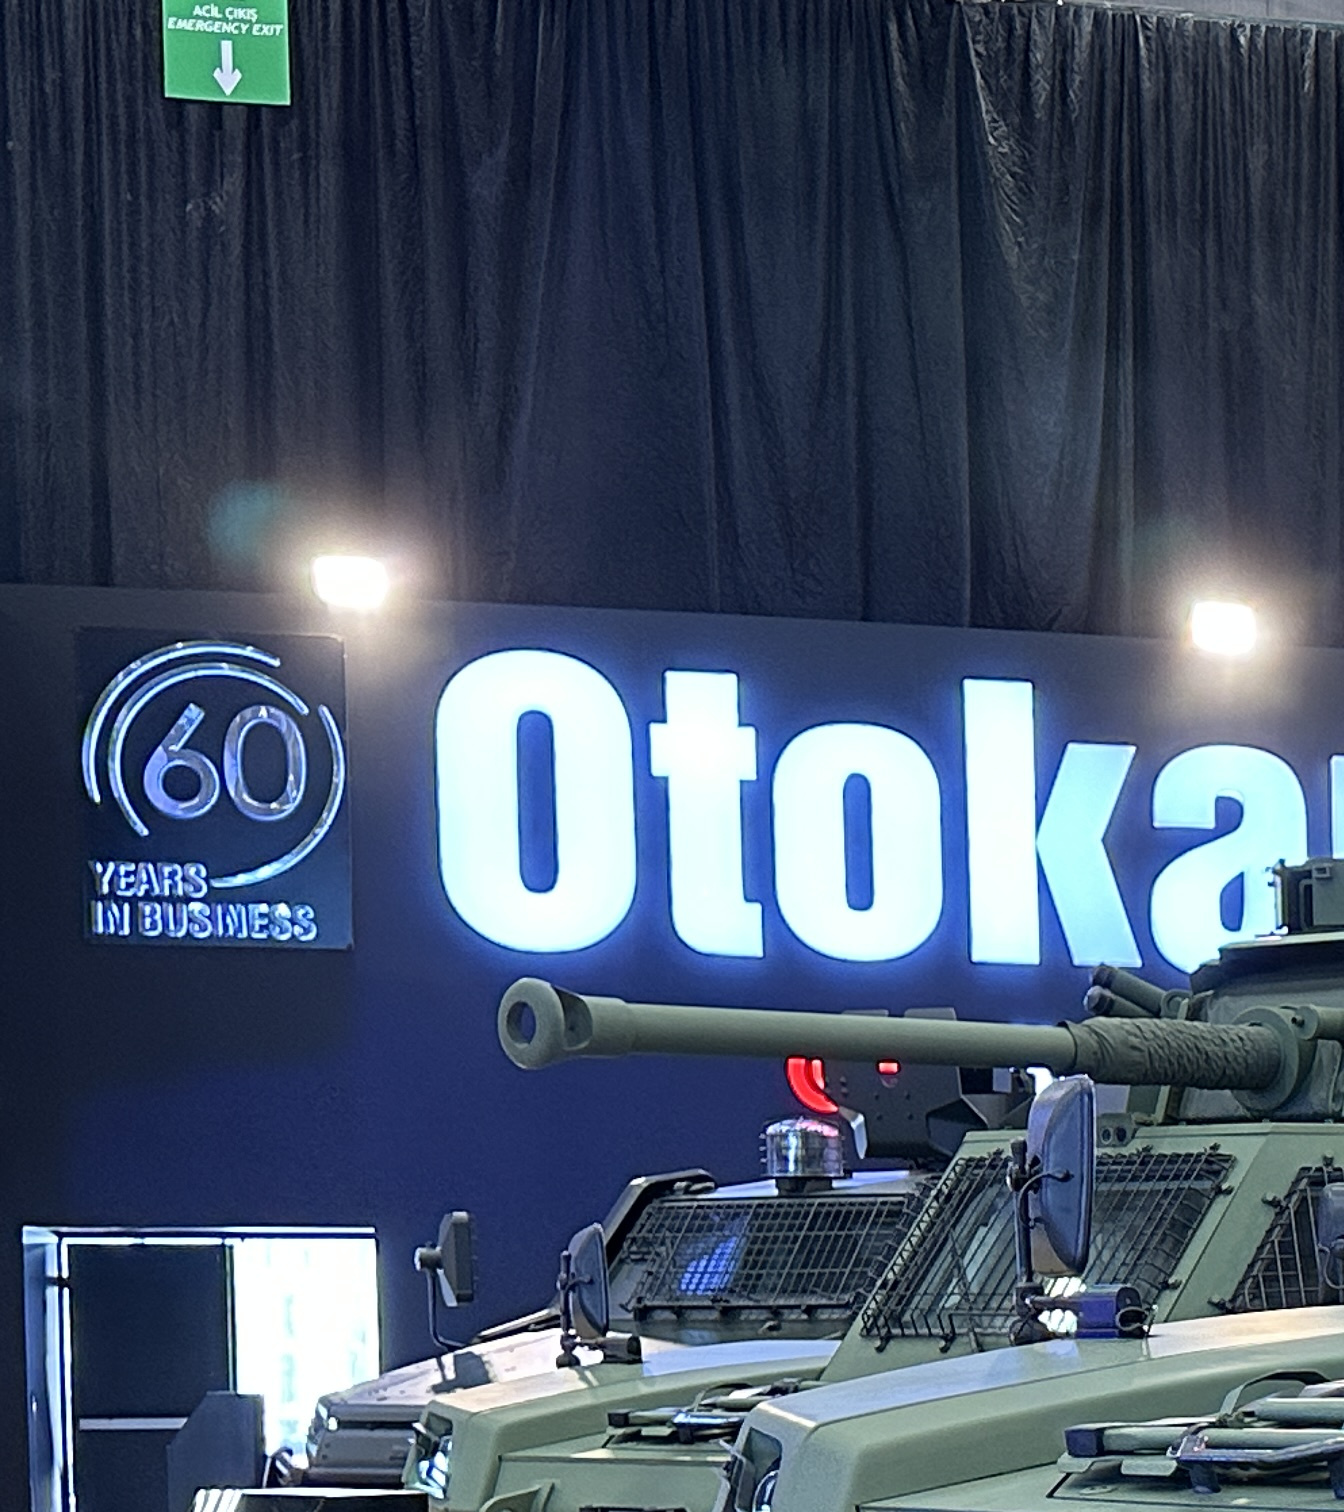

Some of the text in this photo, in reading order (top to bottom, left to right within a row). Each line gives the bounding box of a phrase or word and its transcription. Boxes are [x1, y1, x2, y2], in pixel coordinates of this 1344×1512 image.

[167, 17, 284, 36] EMERGENCY EXIT
[225, 7, 258, 23] ÇIKIŞ
[143, 702, 308, 822] 60
[89, 861, 208, 900] YEARS
[91, 900, 319, 943] IN BUSINESS
